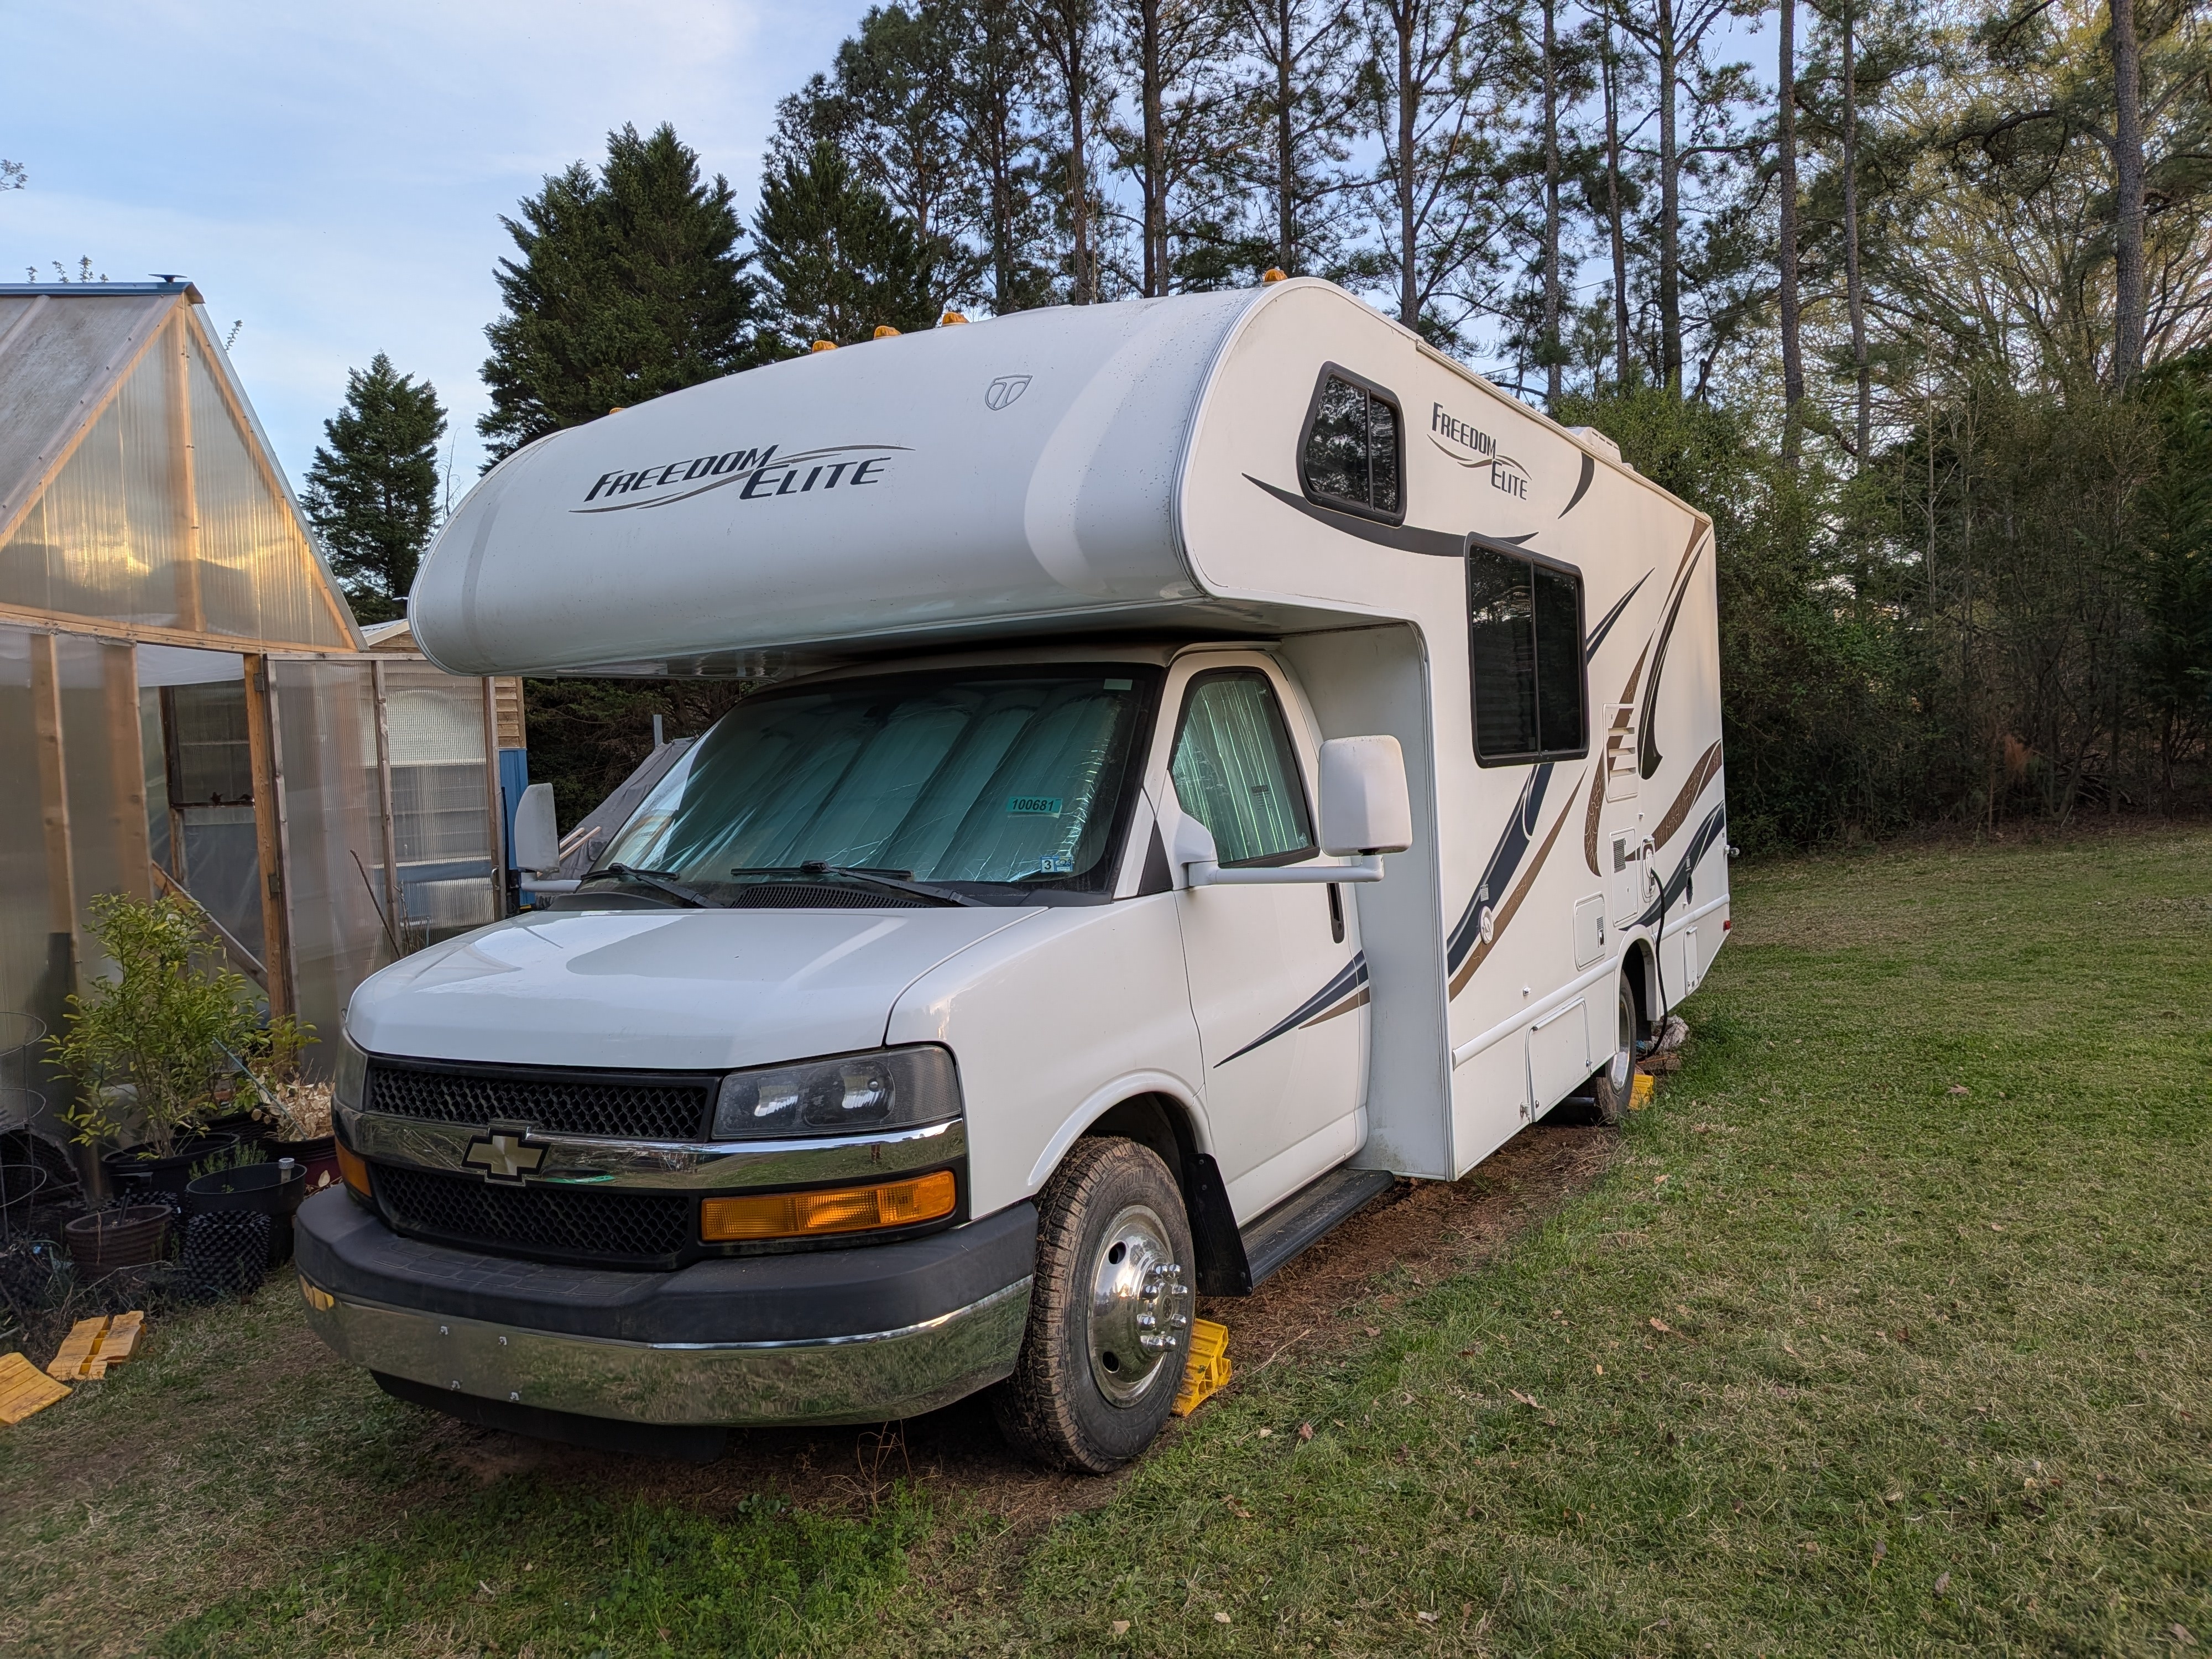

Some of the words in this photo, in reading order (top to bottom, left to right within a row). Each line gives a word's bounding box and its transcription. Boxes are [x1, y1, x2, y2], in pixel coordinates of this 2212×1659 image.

[1432, 401, 1496, 458] FREEDOM
[584, 445, 779, 502] FREEDOM
[740, 457, 891, 500] ELITE
[1491, 461, 1528, 500] ELITE
[1013, 799, 1053, 811] 100681
[1044, 860, 1052, 870] 3
